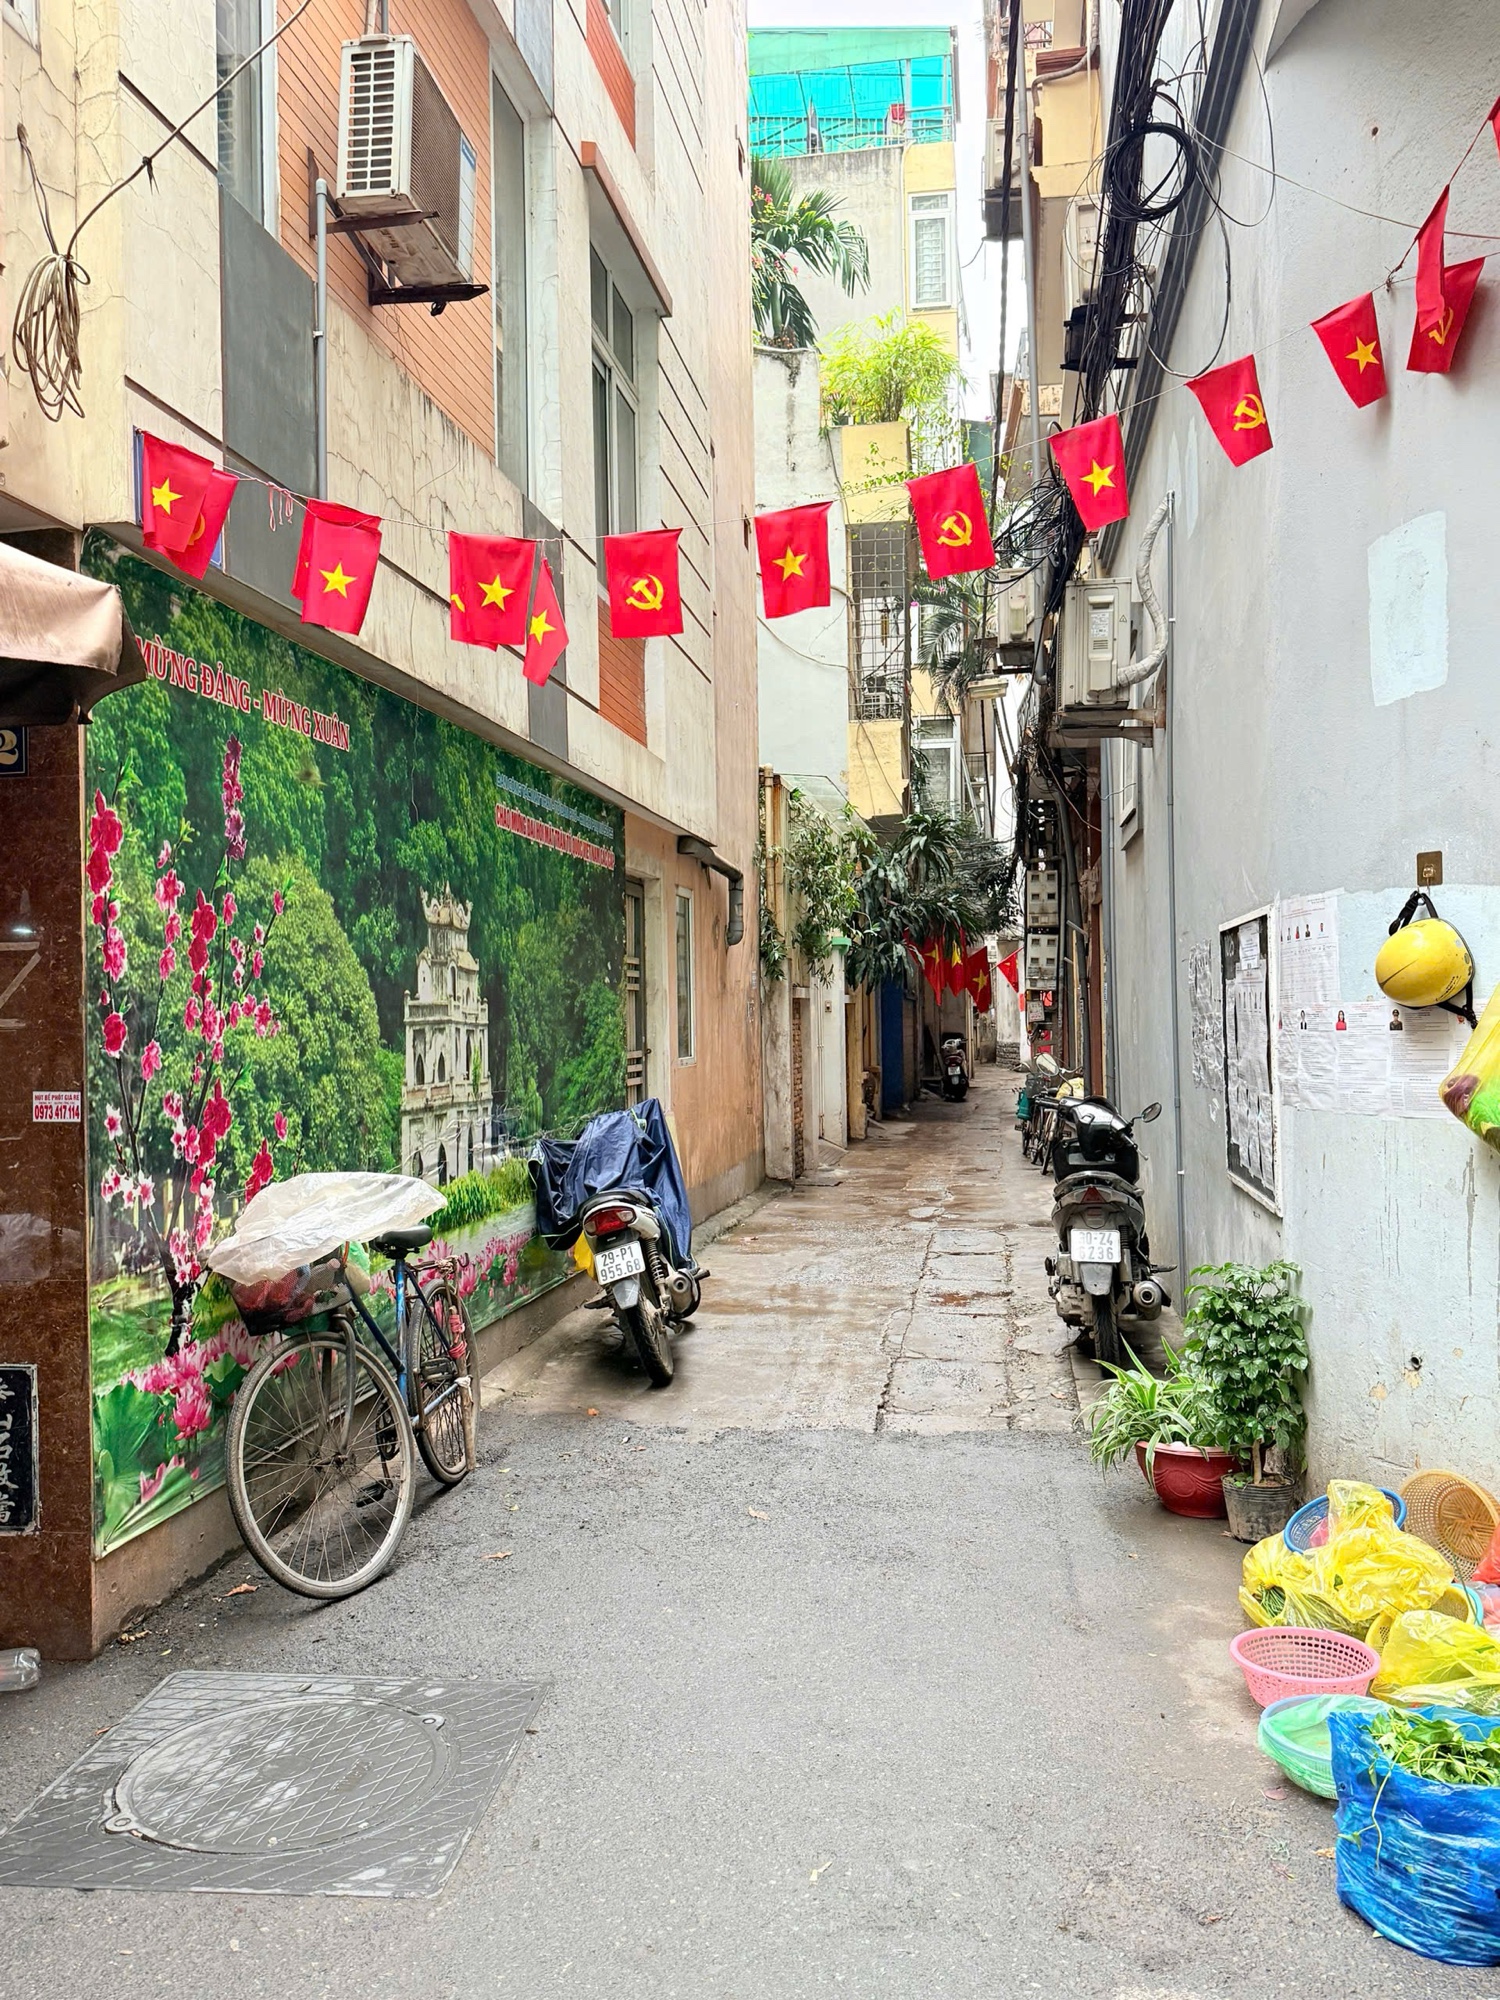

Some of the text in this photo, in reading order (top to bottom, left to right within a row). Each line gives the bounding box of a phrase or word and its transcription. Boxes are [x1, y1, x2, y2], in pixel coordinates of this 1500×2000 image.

[134, 633, 198, 694] MỪNG
[200, 661, 250, 714] ĐẢNG
[262, 688, 312, 737] MỪNG
[312, 710, 350, 753] XUÂN
[601, 1245, 634, 1267] 29-P1
[600, 1258, 641, 1282] 955.68
